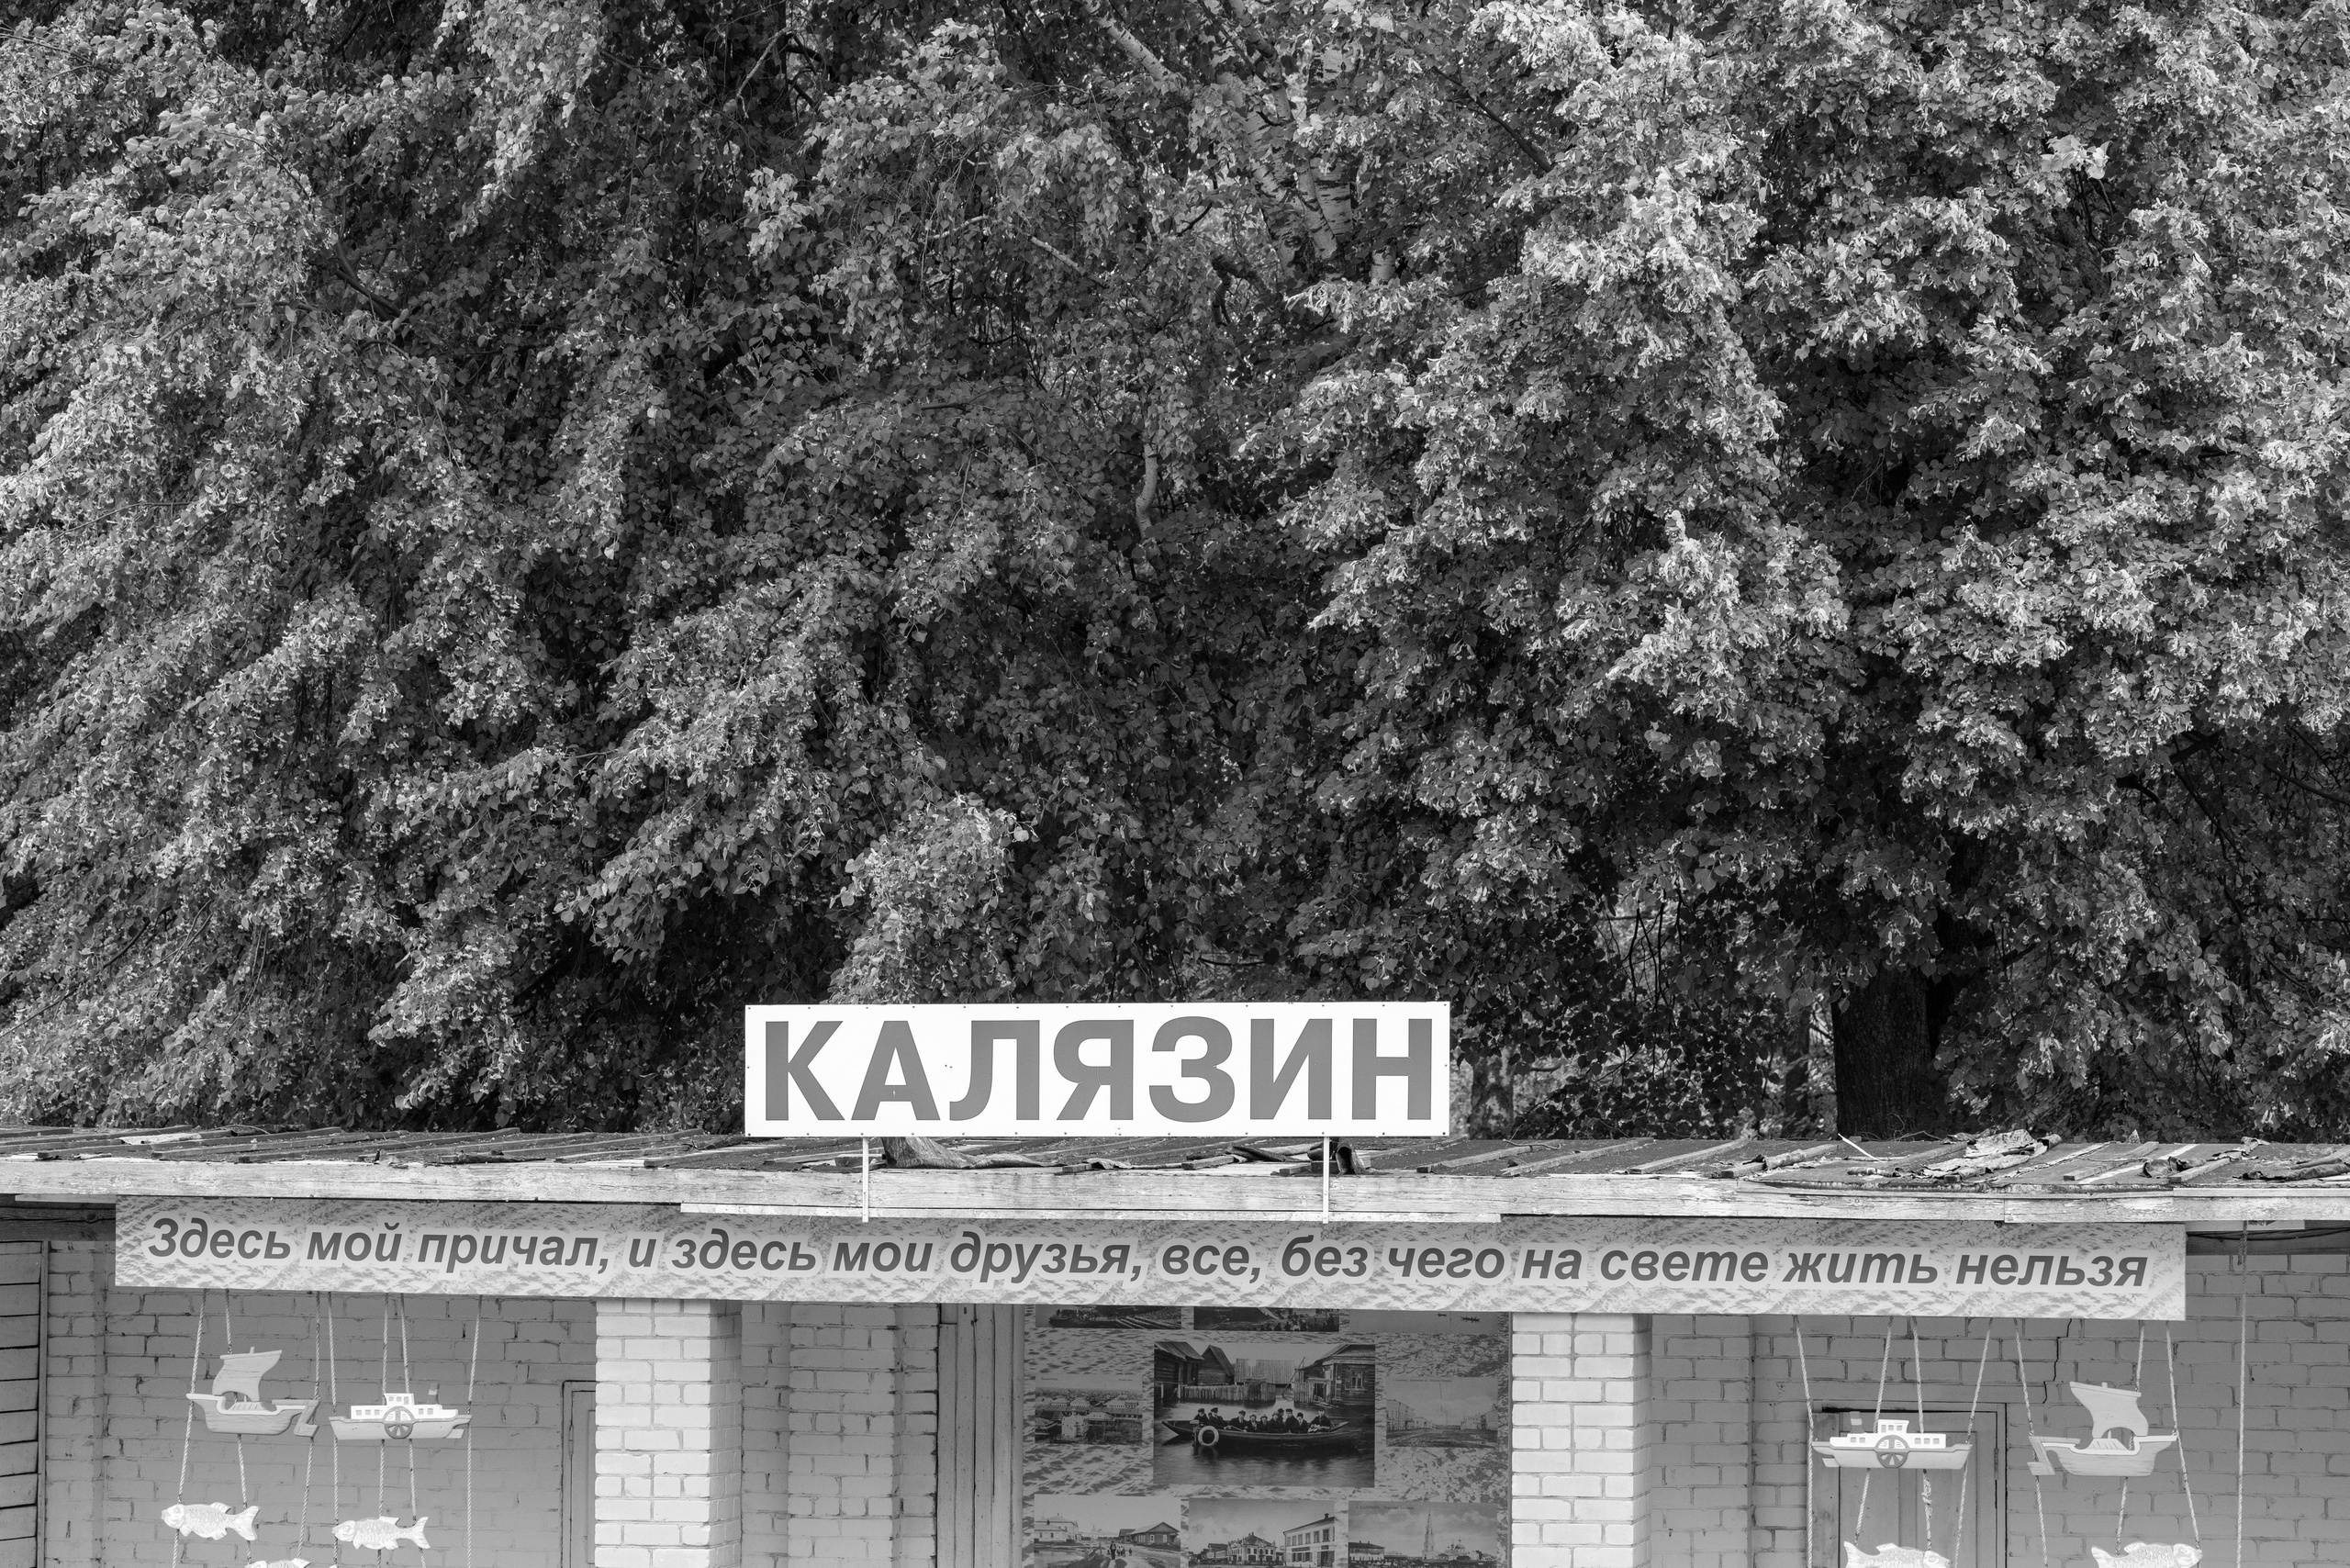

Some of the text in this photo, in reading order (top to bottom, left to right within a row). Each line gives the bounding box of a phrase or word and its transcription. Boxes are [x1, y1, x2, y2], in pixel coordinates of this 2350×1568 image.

[765, 1016, 1433, 1123] КАЛЯЗИН
[147, 1217, 2149, 1286] Здесь мой причал, и здесь мои друзья, все, без чего на свете жить нельзя
